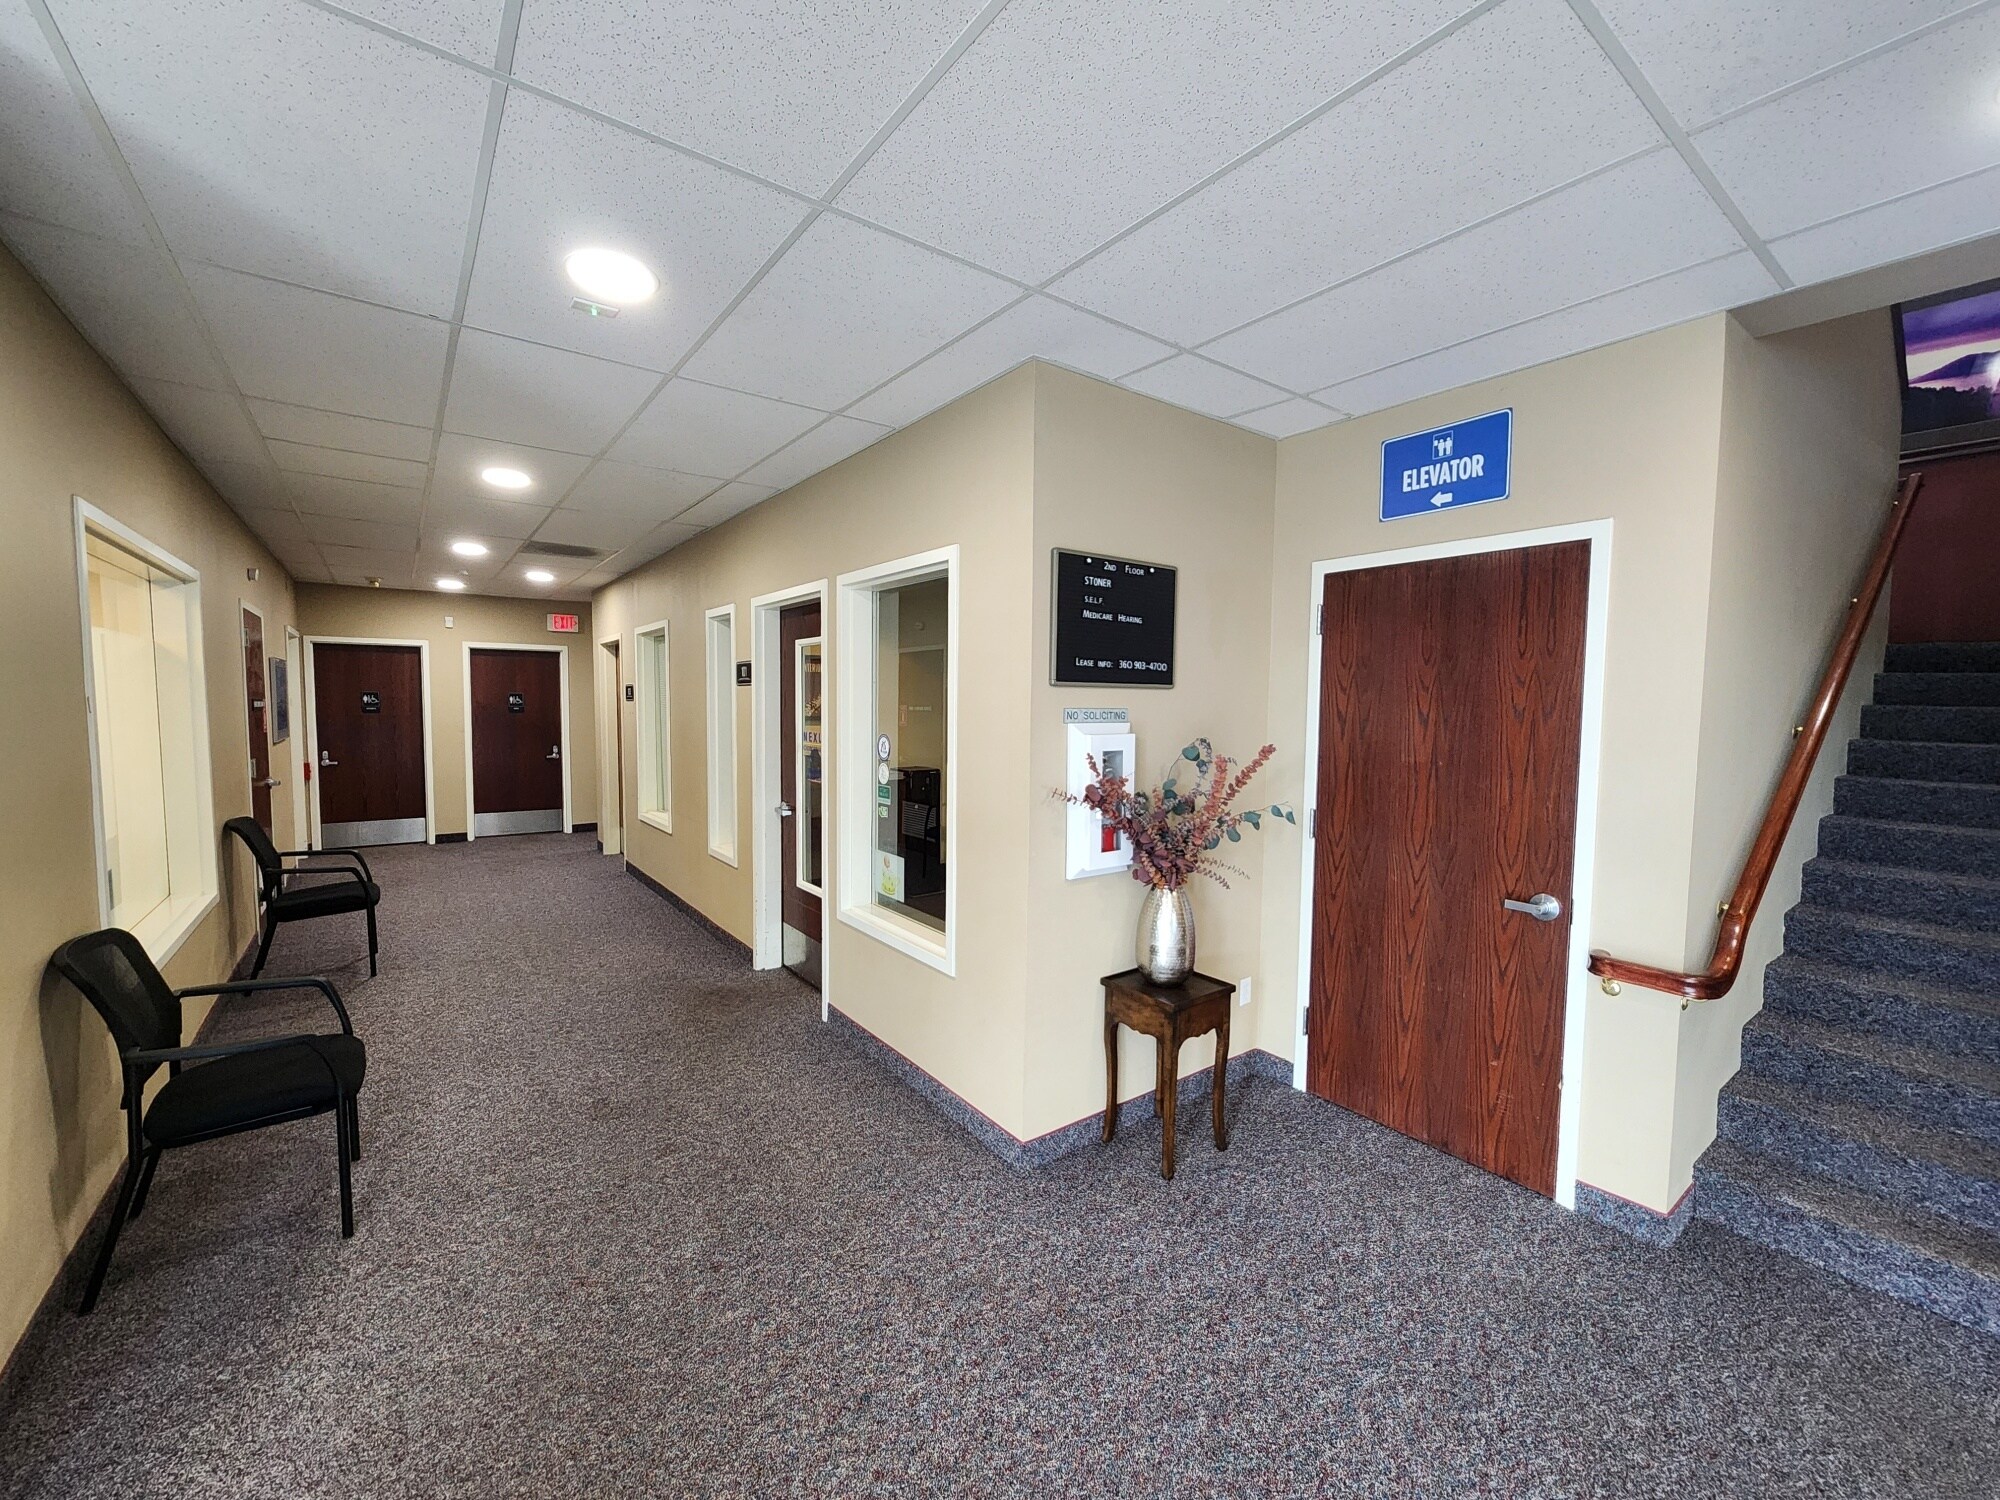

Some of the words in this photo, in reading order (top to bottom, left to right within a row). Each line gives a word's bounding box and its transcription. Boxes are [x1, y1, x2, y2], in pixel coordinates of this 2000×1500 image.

[1402, 454, 1485, 492] ELEVATOR
[1125, 564, 1145, 576] FLOOR
[1084, 575, 1112, 588] STONER
[553, 615, 574, 630] EXIT
[1082, 609, 1113, 621] MEDICARE
[1117, 613, 1143, 624] HEARING
[1075, 657, 1094, 667] LEASE
[1097, 660, 1113, 668] INFO:
[1118, 660, 1133, 669] 360
[1066, 711, 1079, 720] NO
[1083, 711, 1126, 720] SOLICITING
